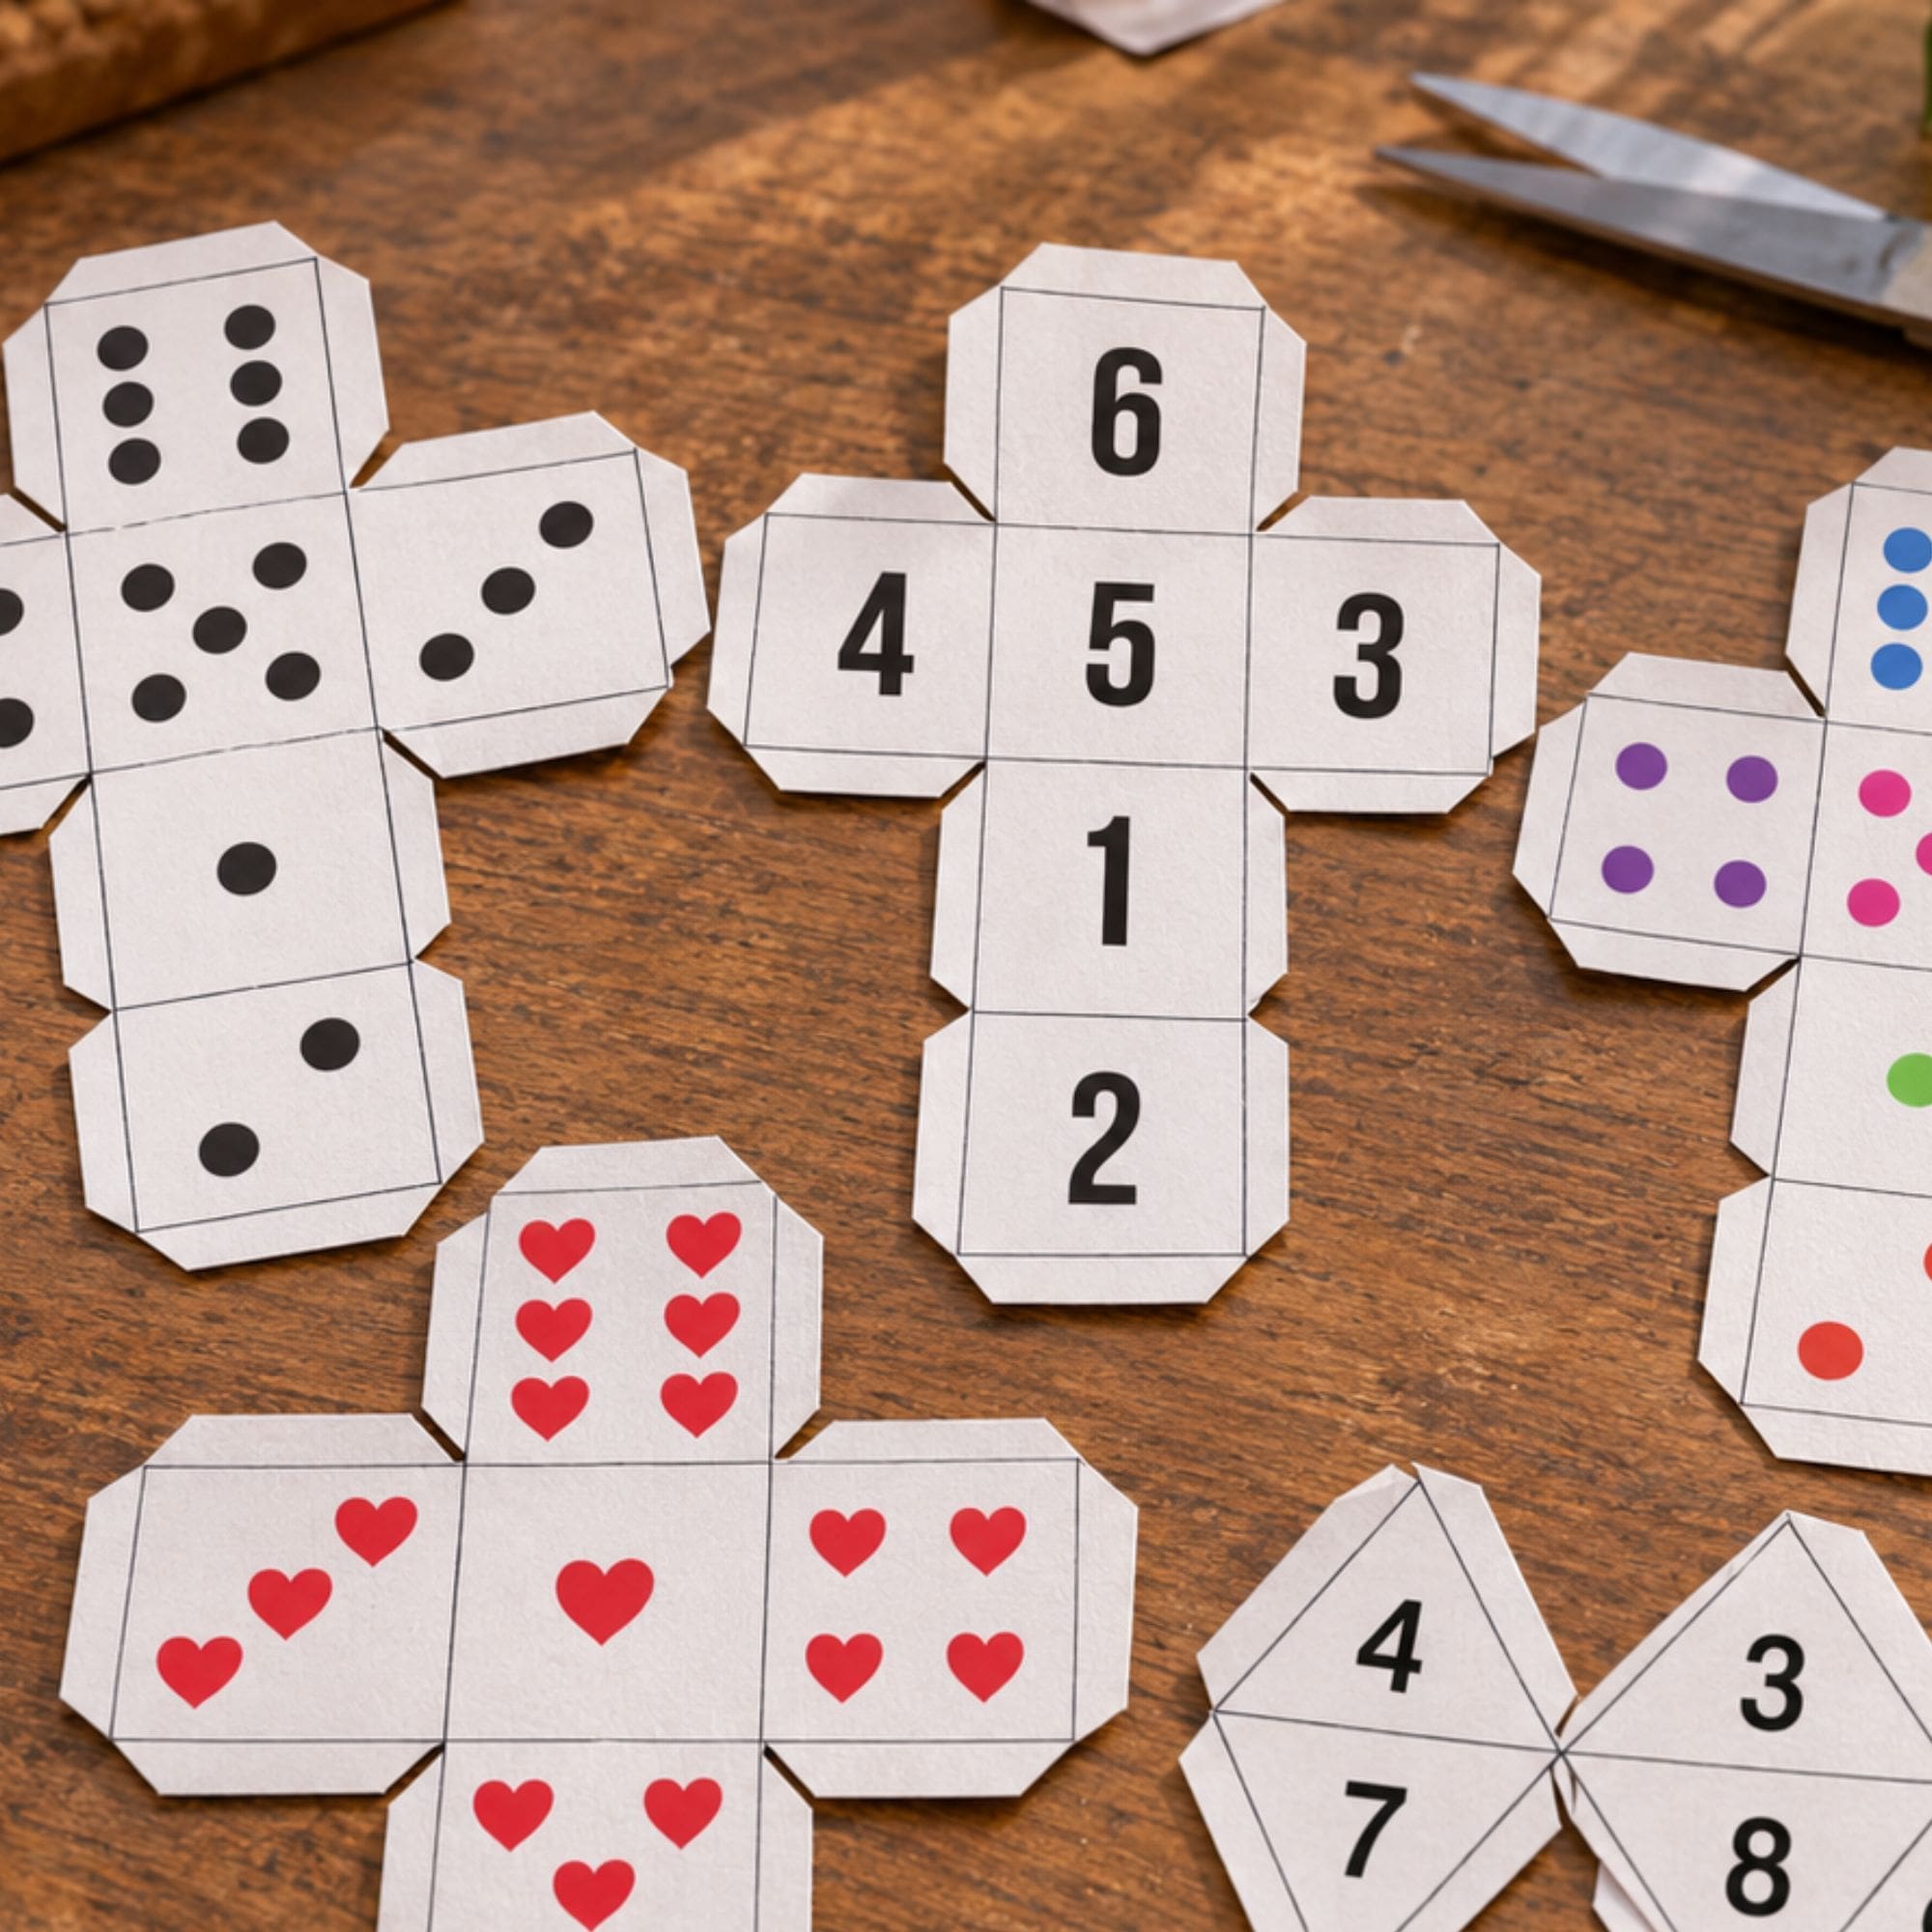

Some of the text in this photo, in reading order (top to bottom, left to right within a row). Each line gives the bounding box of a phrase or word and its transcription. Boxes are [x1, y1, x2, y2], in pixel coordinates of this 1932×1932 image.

[1092, 347, 1162, 476] 6
[838, 572, 915, 696] 4
[1086, 582, 1155, 707] 5
[1333, 592, 1404, 720] 3
[1087, 815, 1130, 947] 1
[1068, 1071, 1141, 1206] 2
[1356, 1599, 1423, 1693] 4
[1740, 1634, 1804, 1732] 3
[1345, 1780, 1407, 1878] 7
[1725, 1817, 1791, 1918] 8
